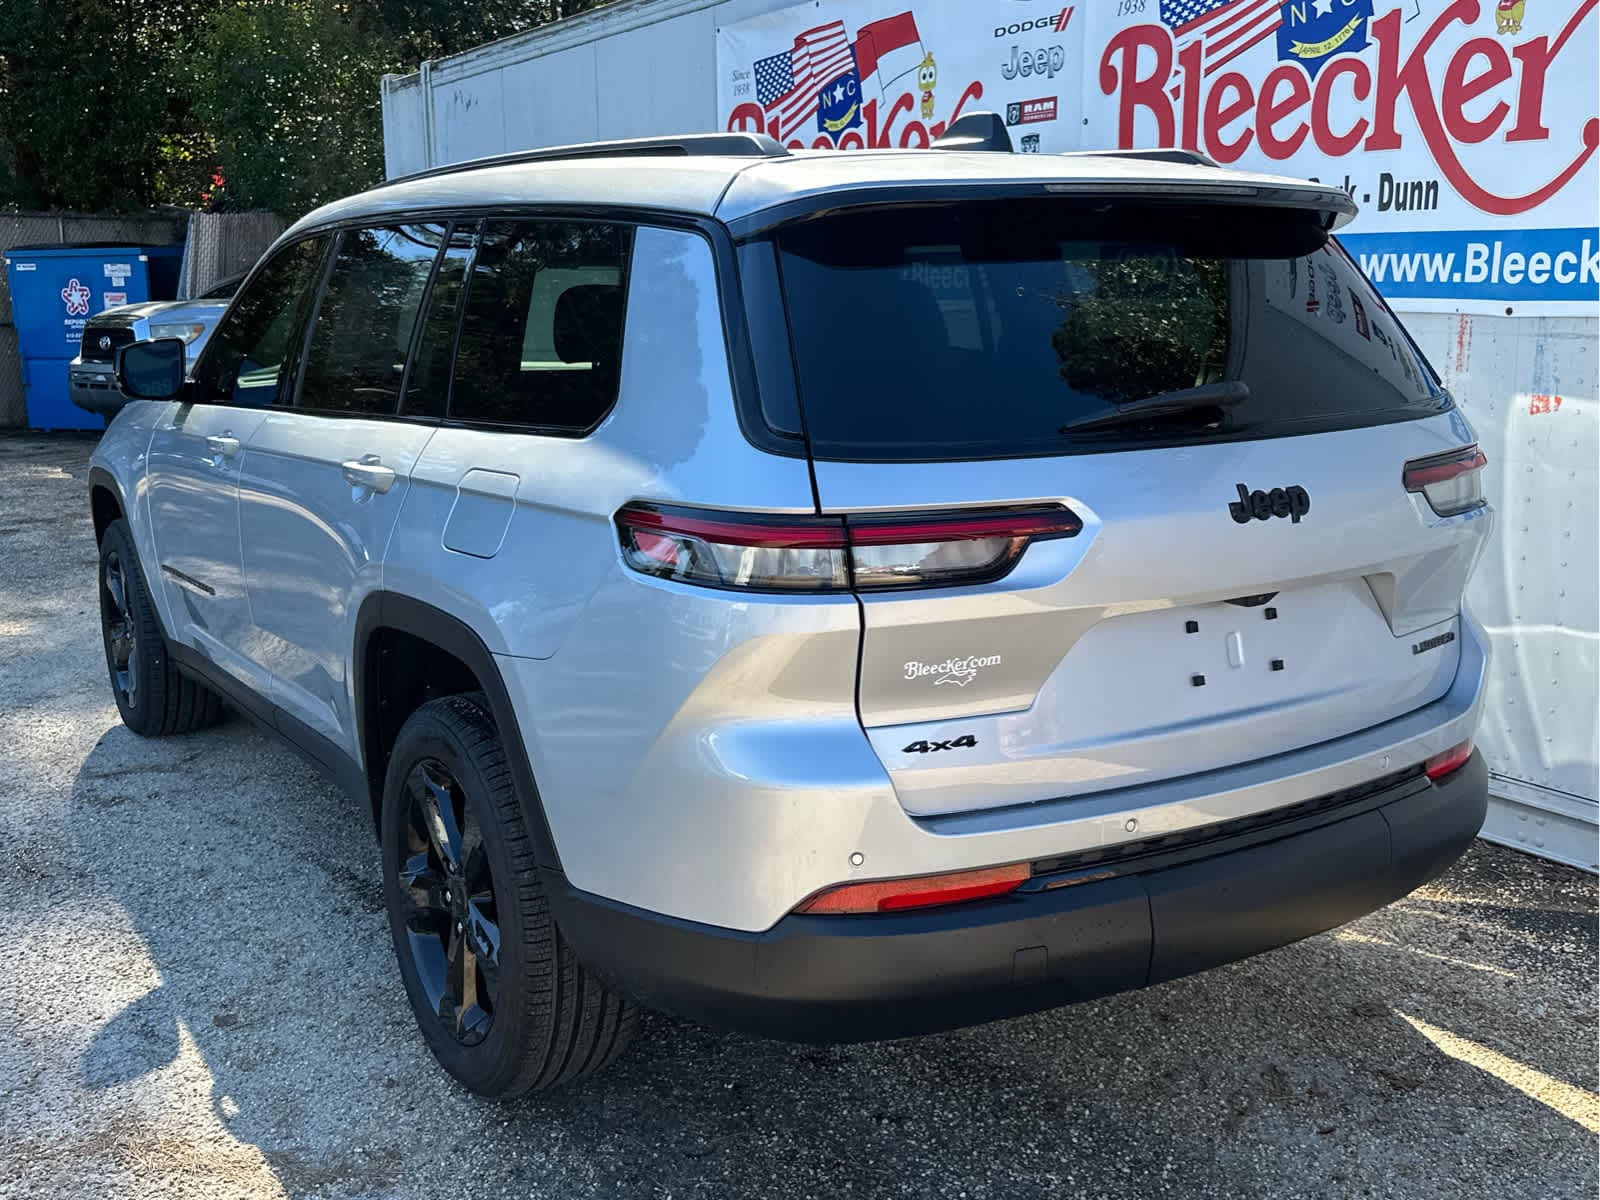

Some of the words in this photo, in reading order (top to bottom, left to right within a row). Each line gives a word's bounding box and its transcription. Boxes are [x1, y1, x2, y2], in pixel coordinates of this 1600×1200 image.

[1117, 0, 1146, 16] 1938
[994, 14, 1063, 38] DODGE
[1001, 45, 1064, 80] Jeep
[1024, 101, 1055, 113] RAM
[1377, 172, 1439, 212] Dunn
[1360, 239, 1600, 285] www.Bleeck
[1228, 483, 1310, 524] Jeep
[902, 735, 978, 753] 4x4
